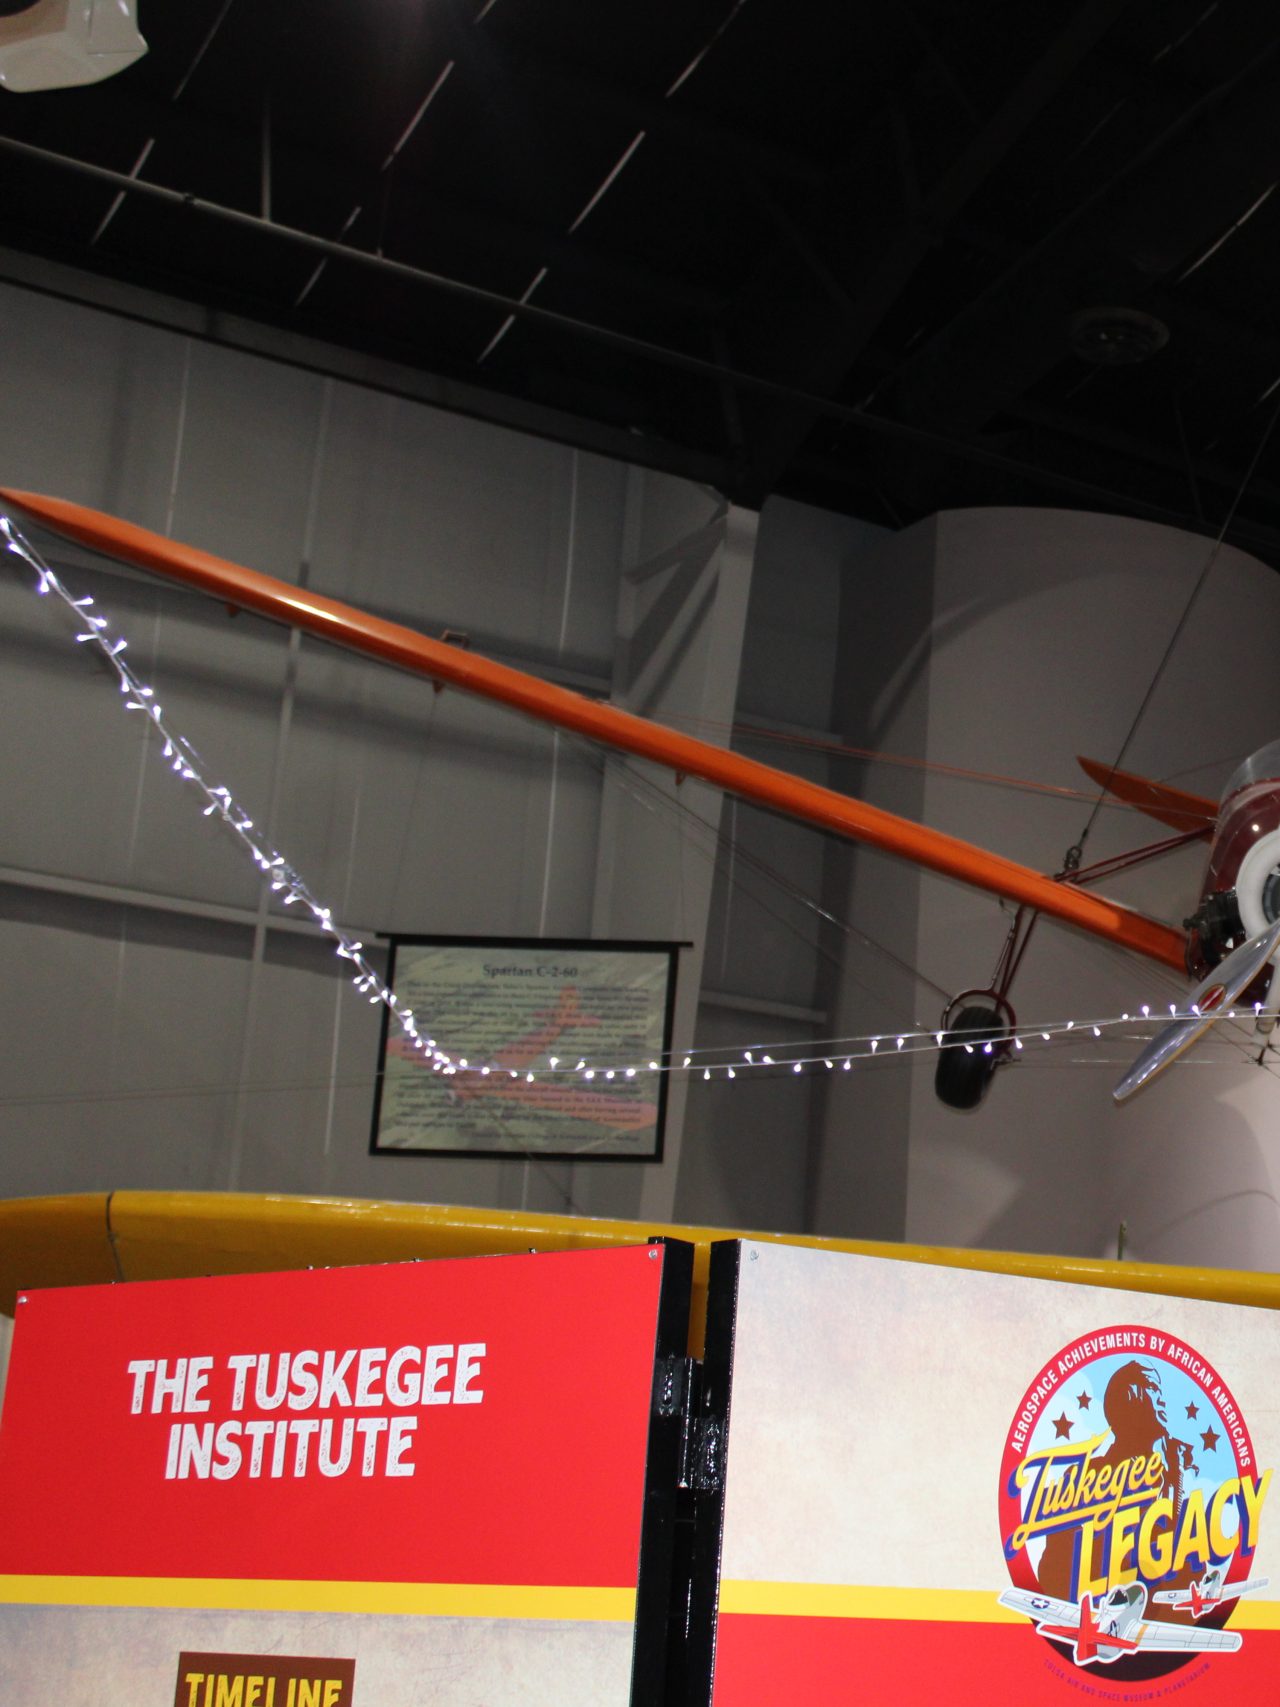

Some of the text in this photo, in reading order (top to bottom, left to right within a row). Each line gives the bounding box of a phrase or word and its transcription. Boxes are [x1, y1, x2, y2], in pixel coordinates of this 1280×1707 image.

[483, 964, 533, 978] Spartan
[127, 1343, 486, 1415] THE TUSKEGEE
[1011, 1332, 1251, 1467] AEROSPACE ACHIEVEMENTS BY AFRICAN AMERICANS
[165, 1416, 418, 1480] INSTITUTE
[1010, 1428, 1164, 1551] Tuskegee
[1074, 1468, 1274, 1600] LEGACY
[185, 1673, 343, 1707] TIMELINE
